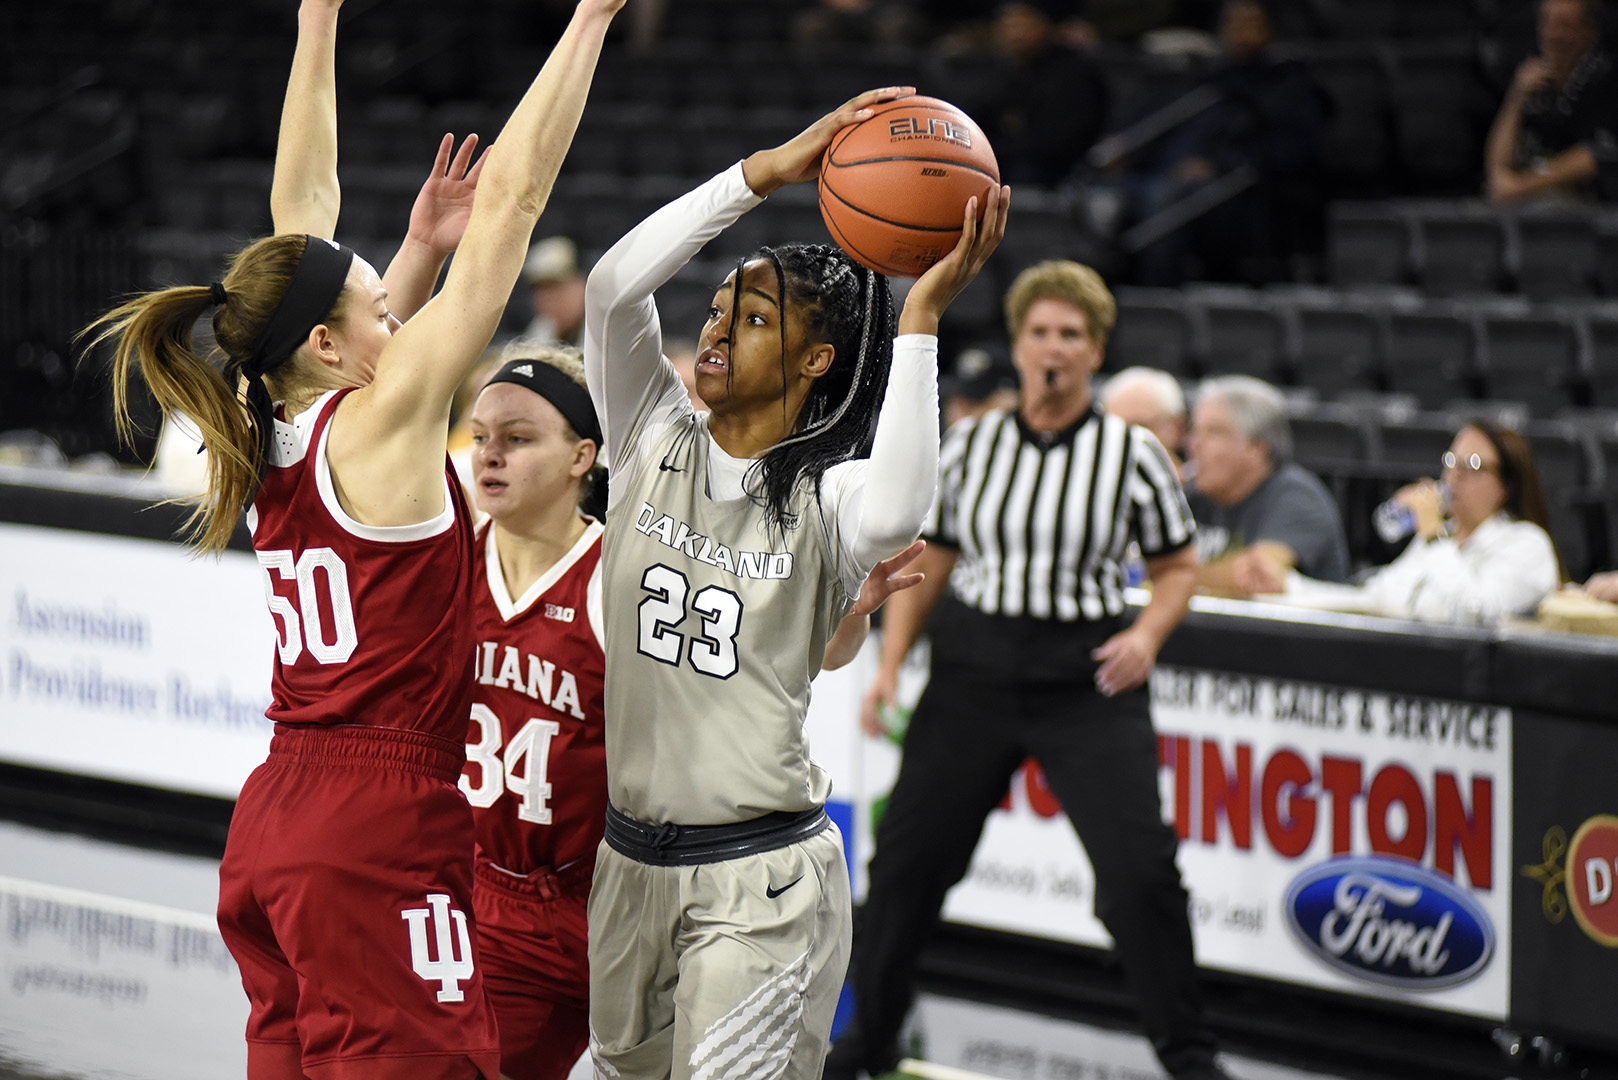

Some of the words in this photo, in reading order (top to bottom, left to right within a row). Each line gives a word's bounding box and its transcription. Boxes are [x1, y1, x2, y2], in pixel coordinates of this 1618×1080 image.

[889, 117, 971, 147] ELITE
[890, 134, 972, 149] CHAMPIONSHIP
[634, 501, 794, 580] OAKLAND
[256, 547, 359, 667] 50
[637, 562, 744, 680] 23
[475, 641, 586, 720] IANA
[1213, 673, 1255, 716] FOR
[1274, 680, 1346, 730] SALES
[1388, 698, 1495, 749] SERVICE
[458, 702, 560, 825] 34
[1156, 733, 1493, 891] INGTON
[1319, 874, 1455, 977] Ford
